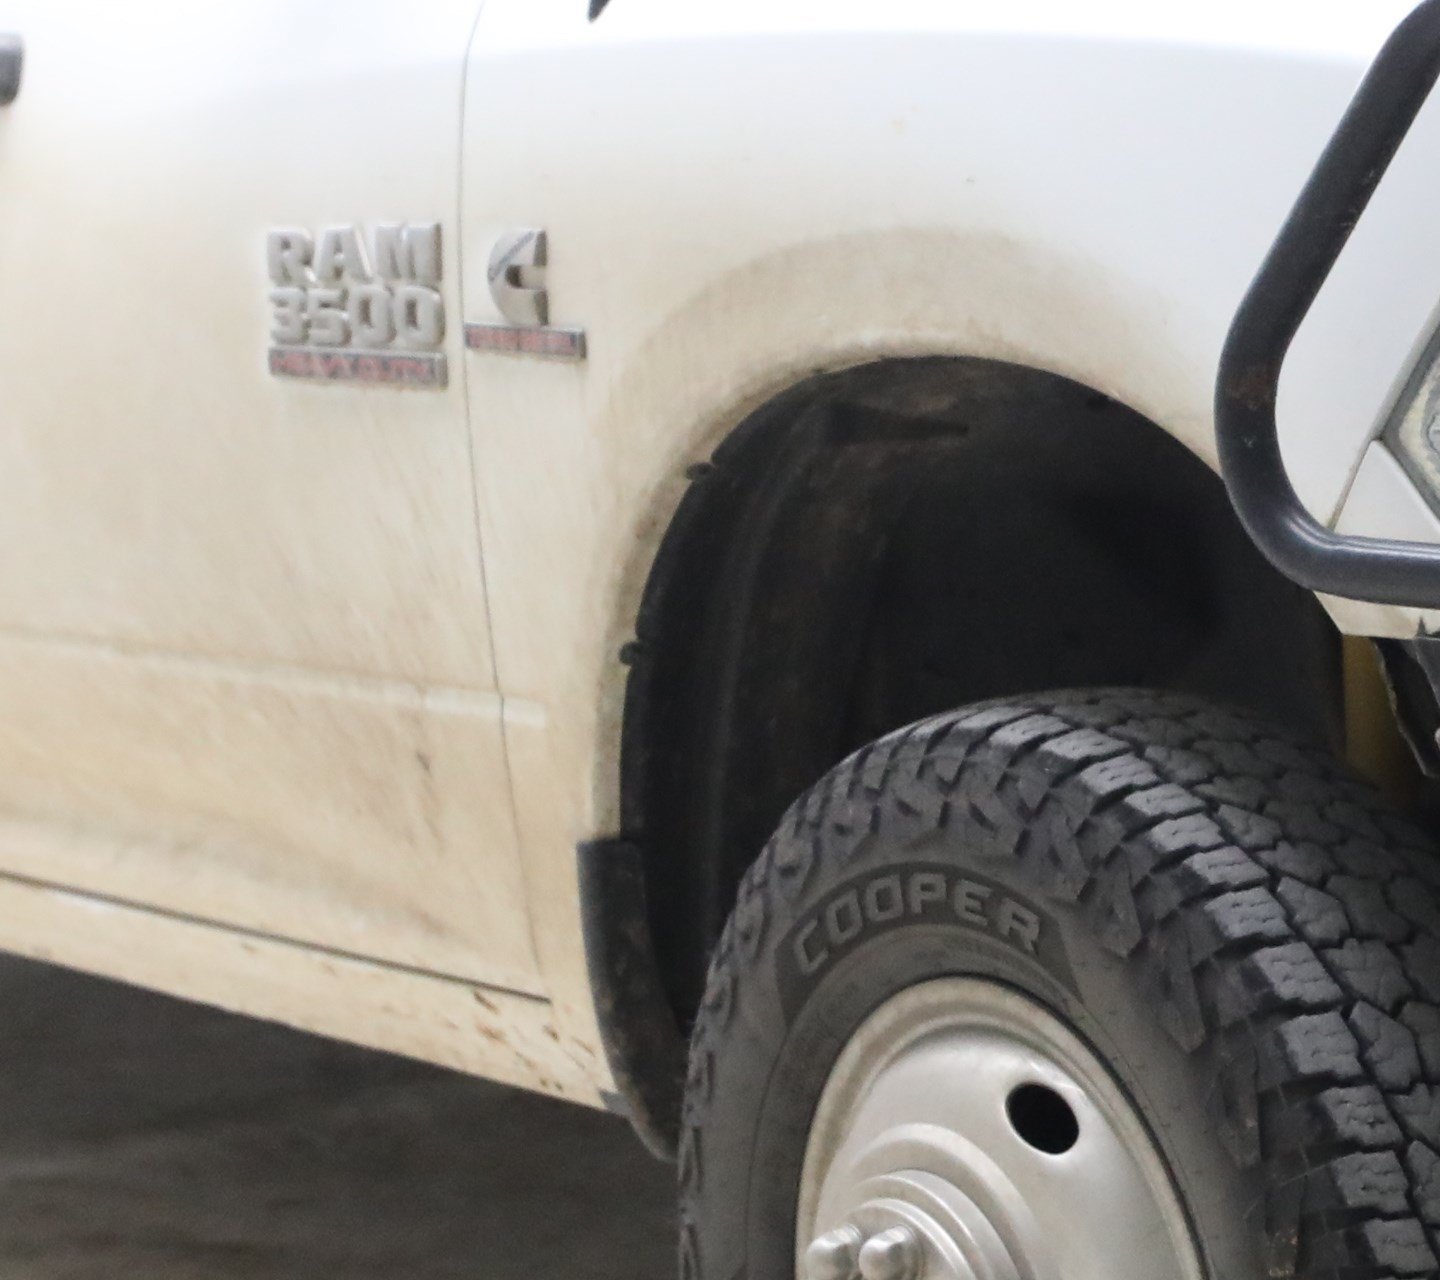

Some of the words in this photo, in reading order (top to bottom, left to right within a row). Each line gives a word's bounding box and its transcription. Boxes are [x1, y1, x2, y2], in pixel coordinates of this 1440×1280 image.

[266, 221, 442, 286] RAM
[269, 284, 444, 347] 3500
[790, 870, 1044, 975] COOPER
